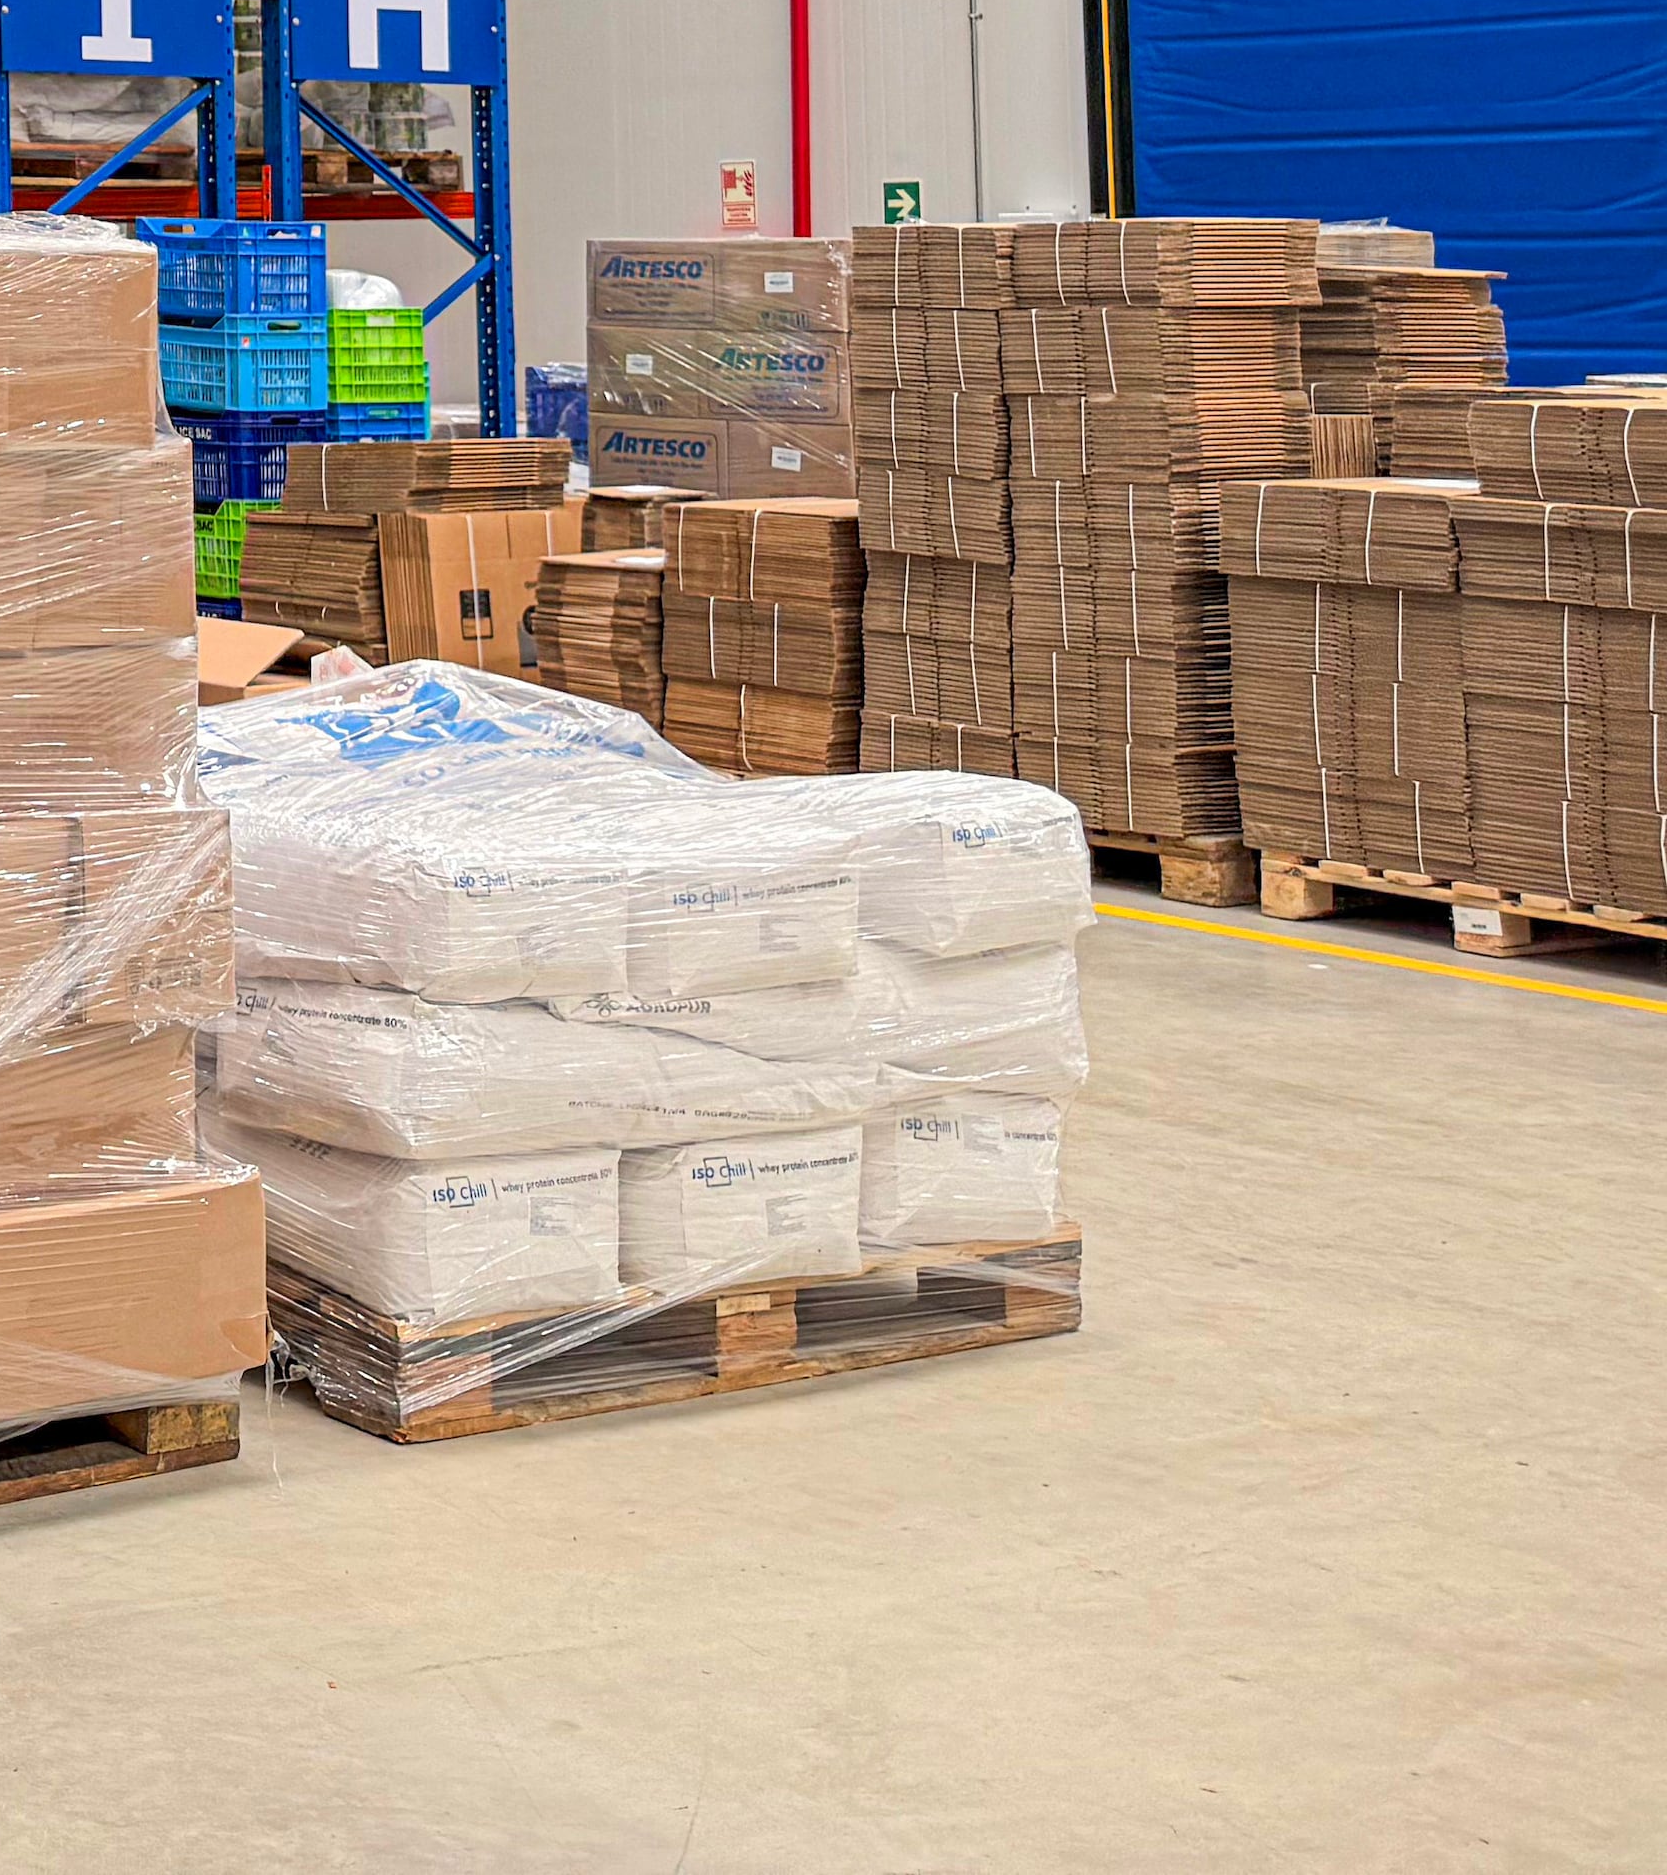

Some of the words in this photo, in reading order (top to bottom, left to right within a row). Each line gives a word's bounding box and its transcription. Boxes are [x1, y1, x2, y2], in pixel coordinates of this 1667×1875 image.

[601, 256, 703, 280] ARTESCO
[716, 348, 826, 373] ARTESCO
[603, 432, 706, 460] ARTESCO
[328, 1011, 382, 1026] concentrate
[384, 1016, 408, 1029] 80%
[719, 1163, 747, 1179] Chill
[782, 1158, 810, 1174] protein
[460, 1184, 488, 1200] Chill
[526, 1176, 556, 1193] protein
